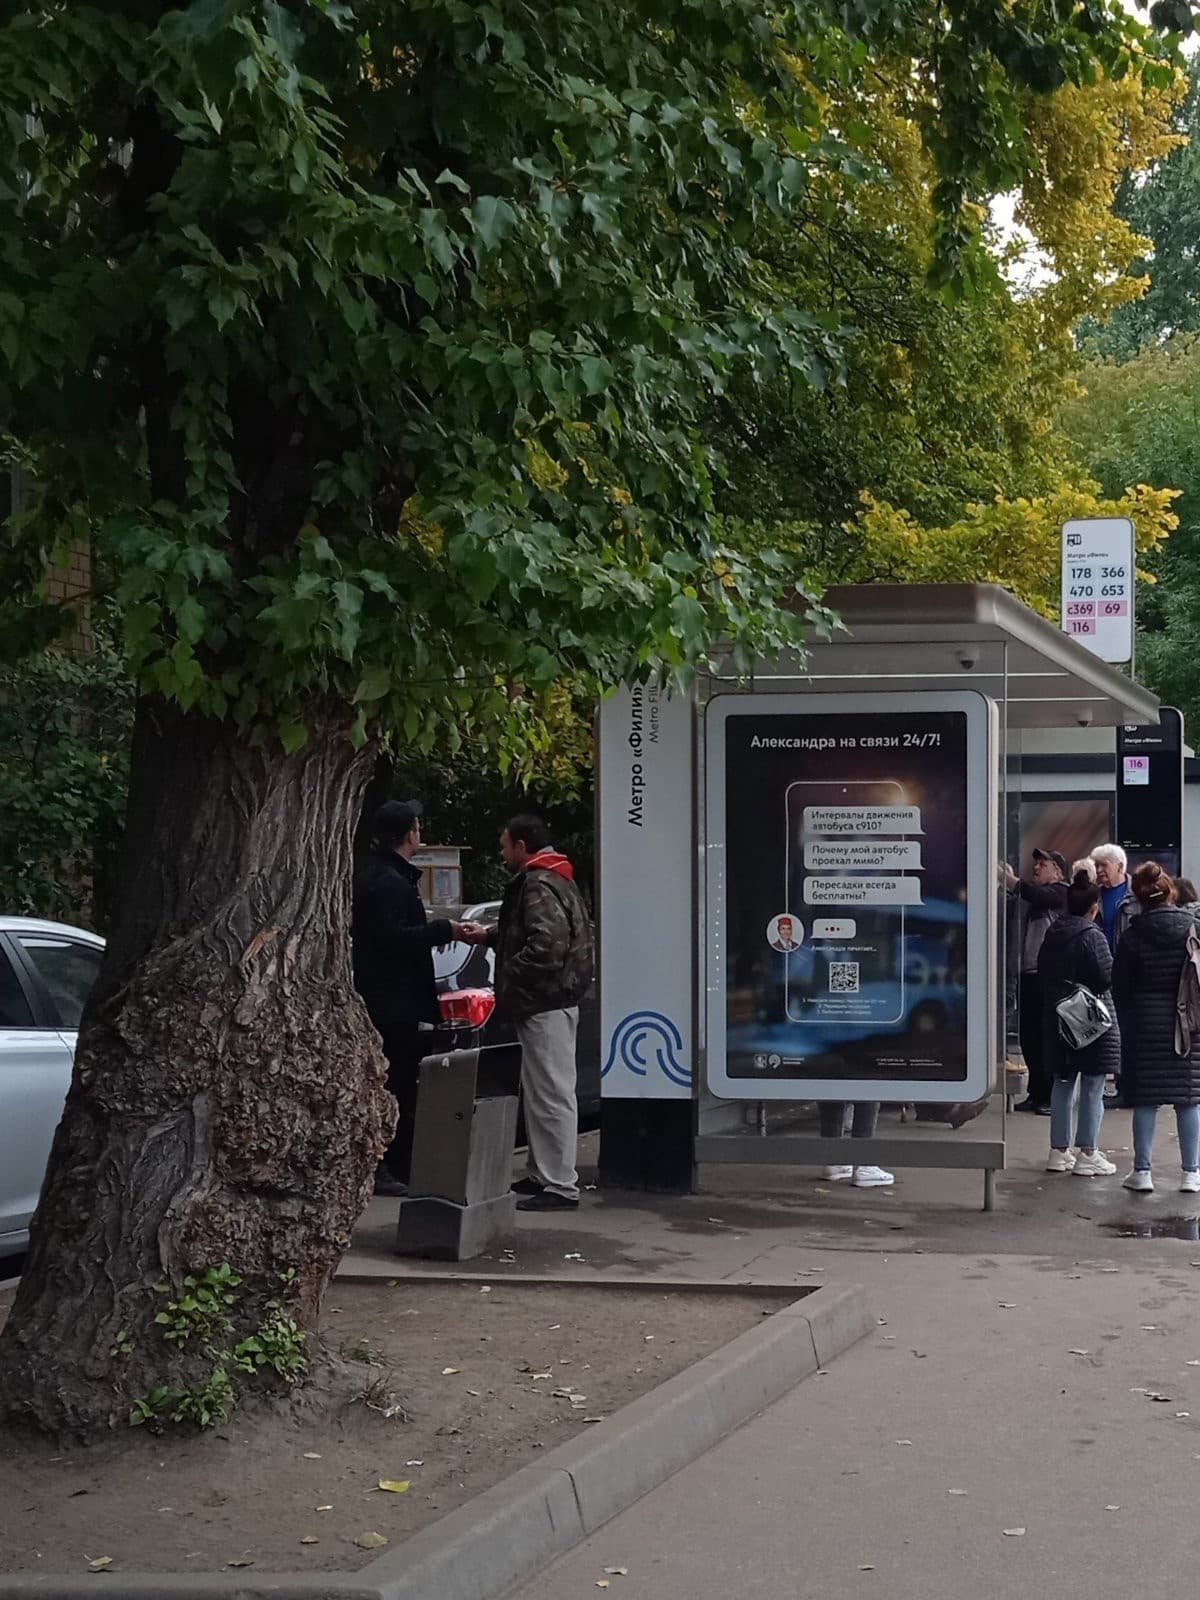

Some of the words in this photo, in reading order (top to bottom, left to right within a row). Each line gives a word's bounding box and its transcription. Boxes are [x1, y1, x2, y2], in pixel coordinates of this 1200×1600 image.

[1071, 568, 1092, 579] 178
[1101, 567, 1125, 578] 366
[1070, 586, 1093, 597] 470
[1101, 585, 1124, 596] 653
[1105, 603, 1120, 614] 69
[1072, 622, 1090, 633] 116
[628, 687, 643, 758] «Фили»
[649, 707, 658, 743] Metro
[750, 735, 836, 750] Александра
[840, 737, 856, 747] на
[860, 736, 899, 747] связи
[903, 733, 941, 747] 24/7!
[1130, 760, 1143, 768] 116
[628, 764, 646, 827] Метро
[812, 811, 864, 821] Интервалы
[813, 822, 853, 832] автобуса
[856, 822, 882, 830] с910?
[812, 845, 847, 855] Почему
[851, 846, 870, 854] мой
[872, 845, 908, 856] автобус
[853, 856, 884, 865] мимо?
[812, 880, 863, 889] Пересадки
[812, 891, 866, 900] бесплатны?
